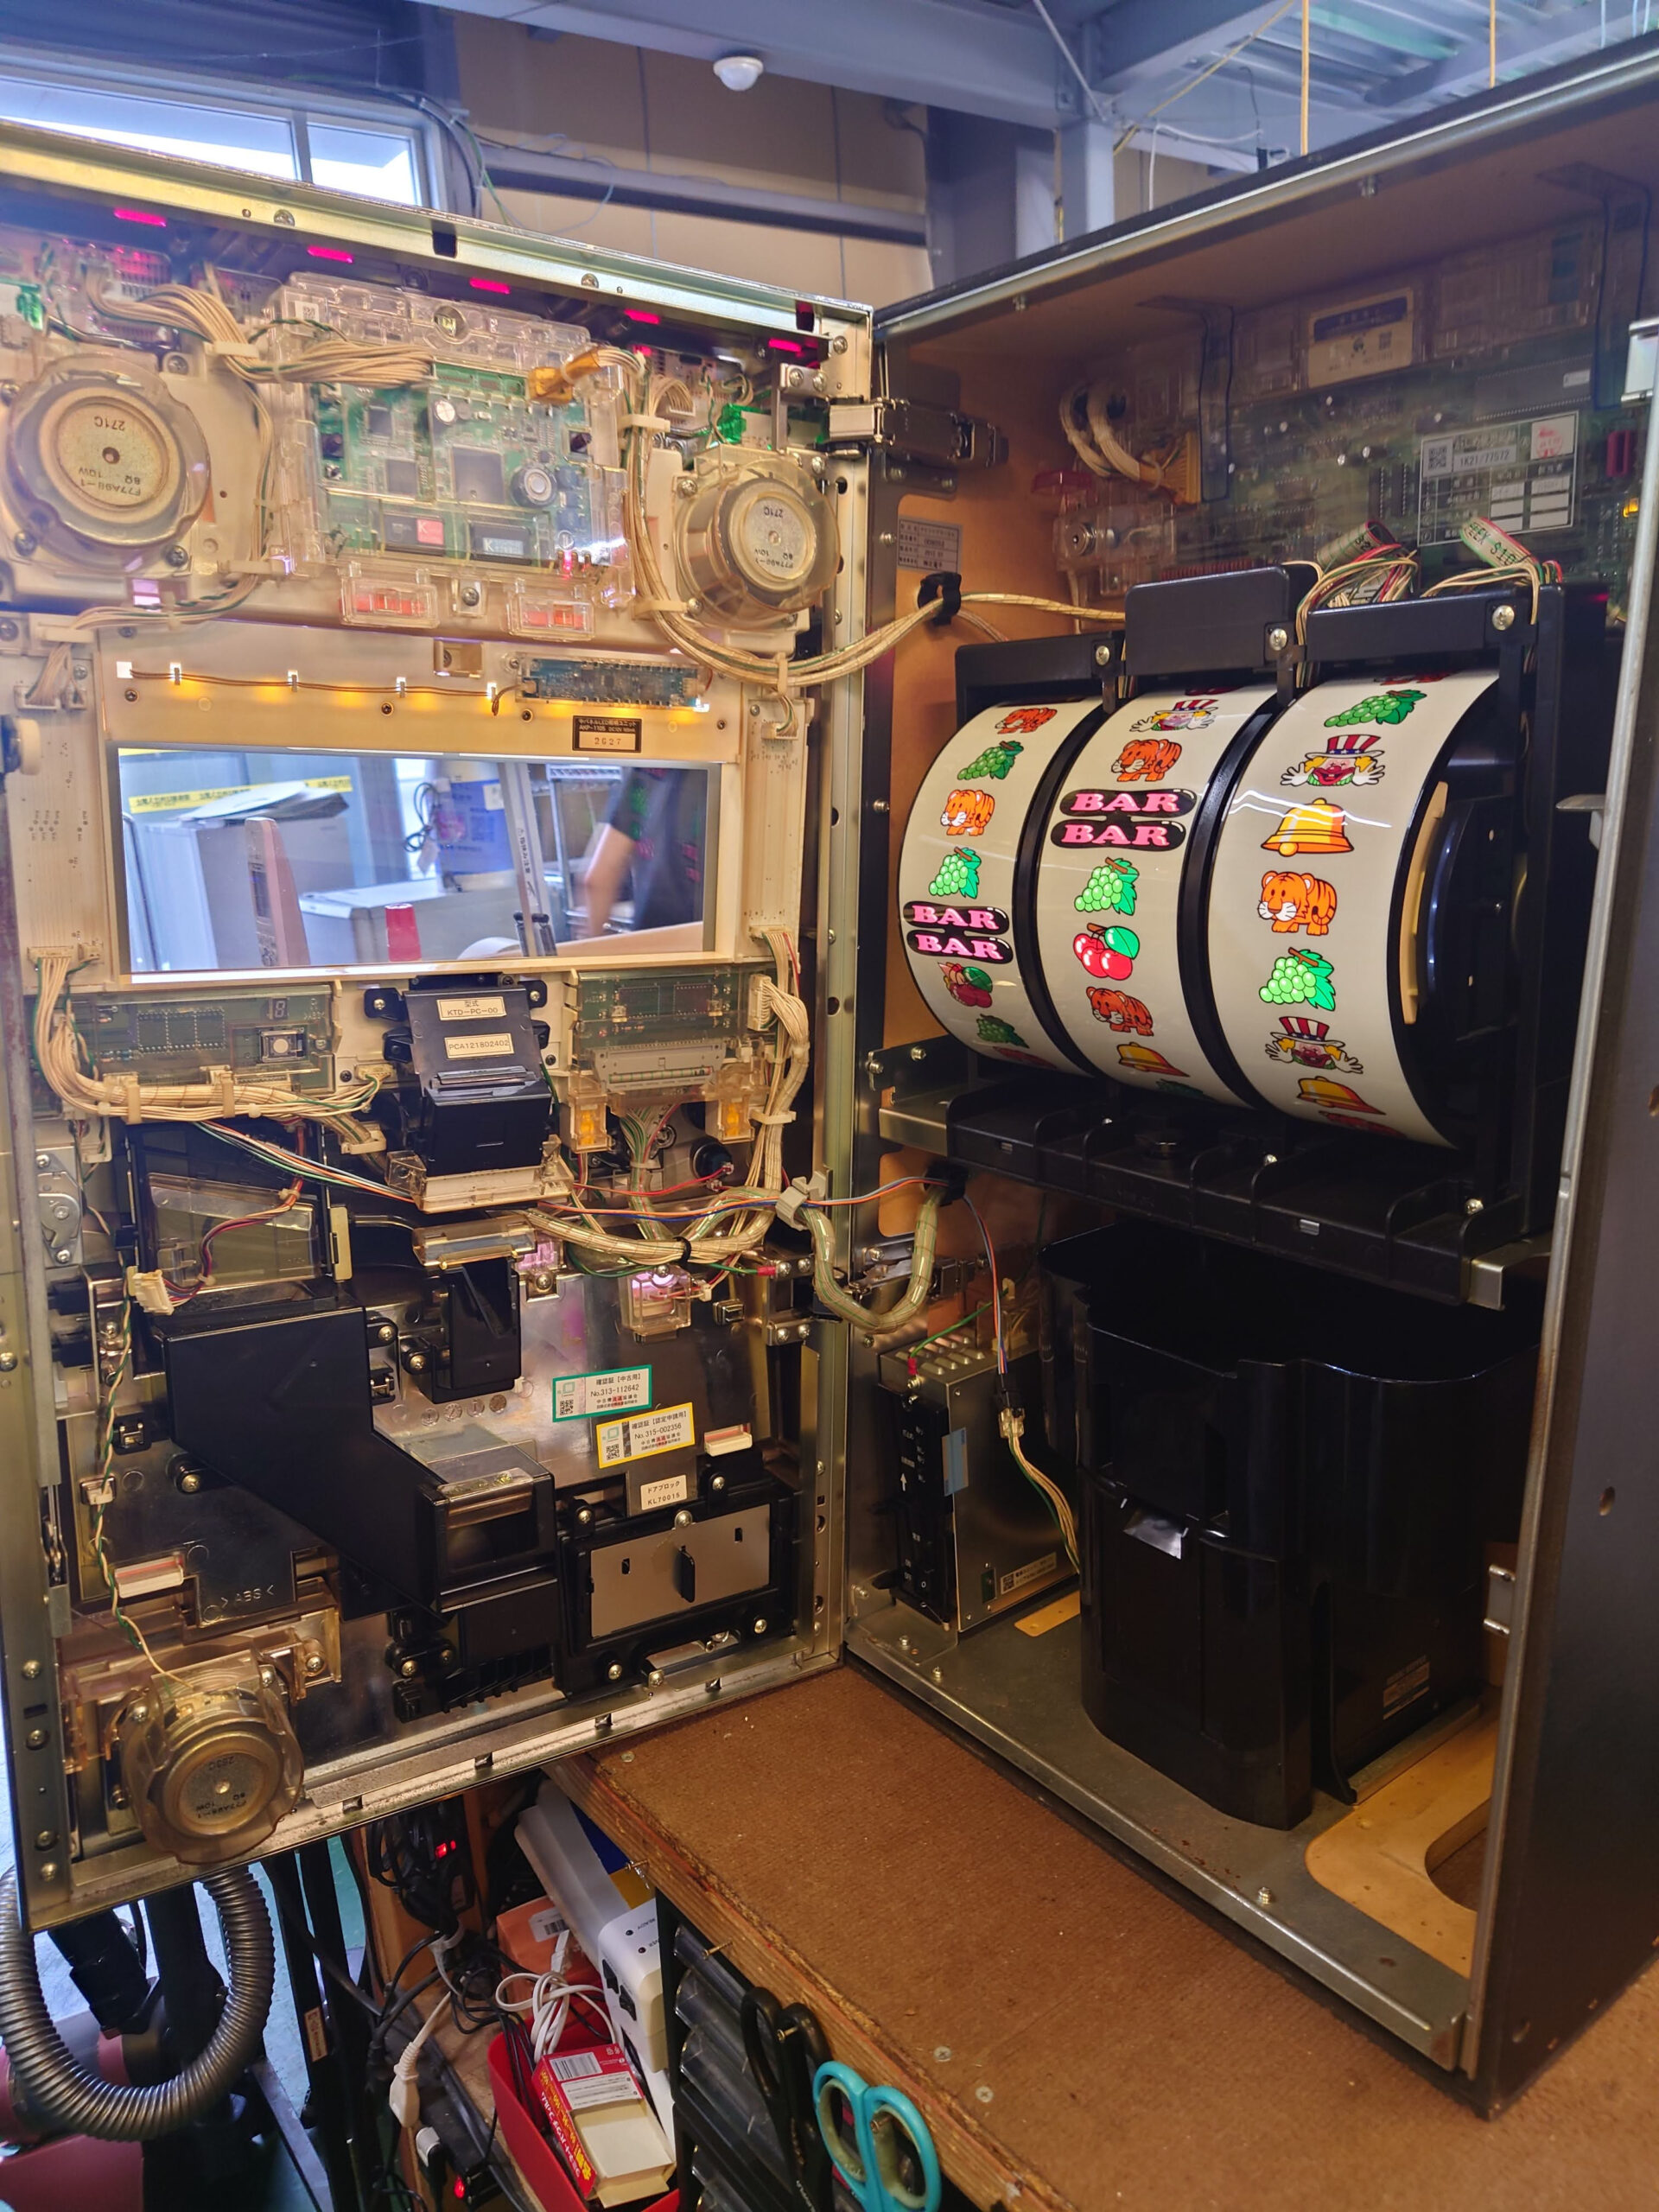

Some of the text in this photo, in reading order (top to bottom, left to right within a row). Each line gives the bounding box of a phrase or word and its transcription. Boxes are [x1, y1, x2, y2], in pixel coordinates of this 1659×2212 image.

[93, 416, 126, 432] 271C
[1071, 792, 1179, 813] BAR
[1061, 823, 1170, 848] BAR
[912, 905, 999, 930] BAR
[915, 934, 1003, 960] BAR
[447, 1007, 499, 1016] KTD-PC-00
[647, 1480, 680, 1494] ドアブロック
[647, 1492, 680, 1506] KL70015
